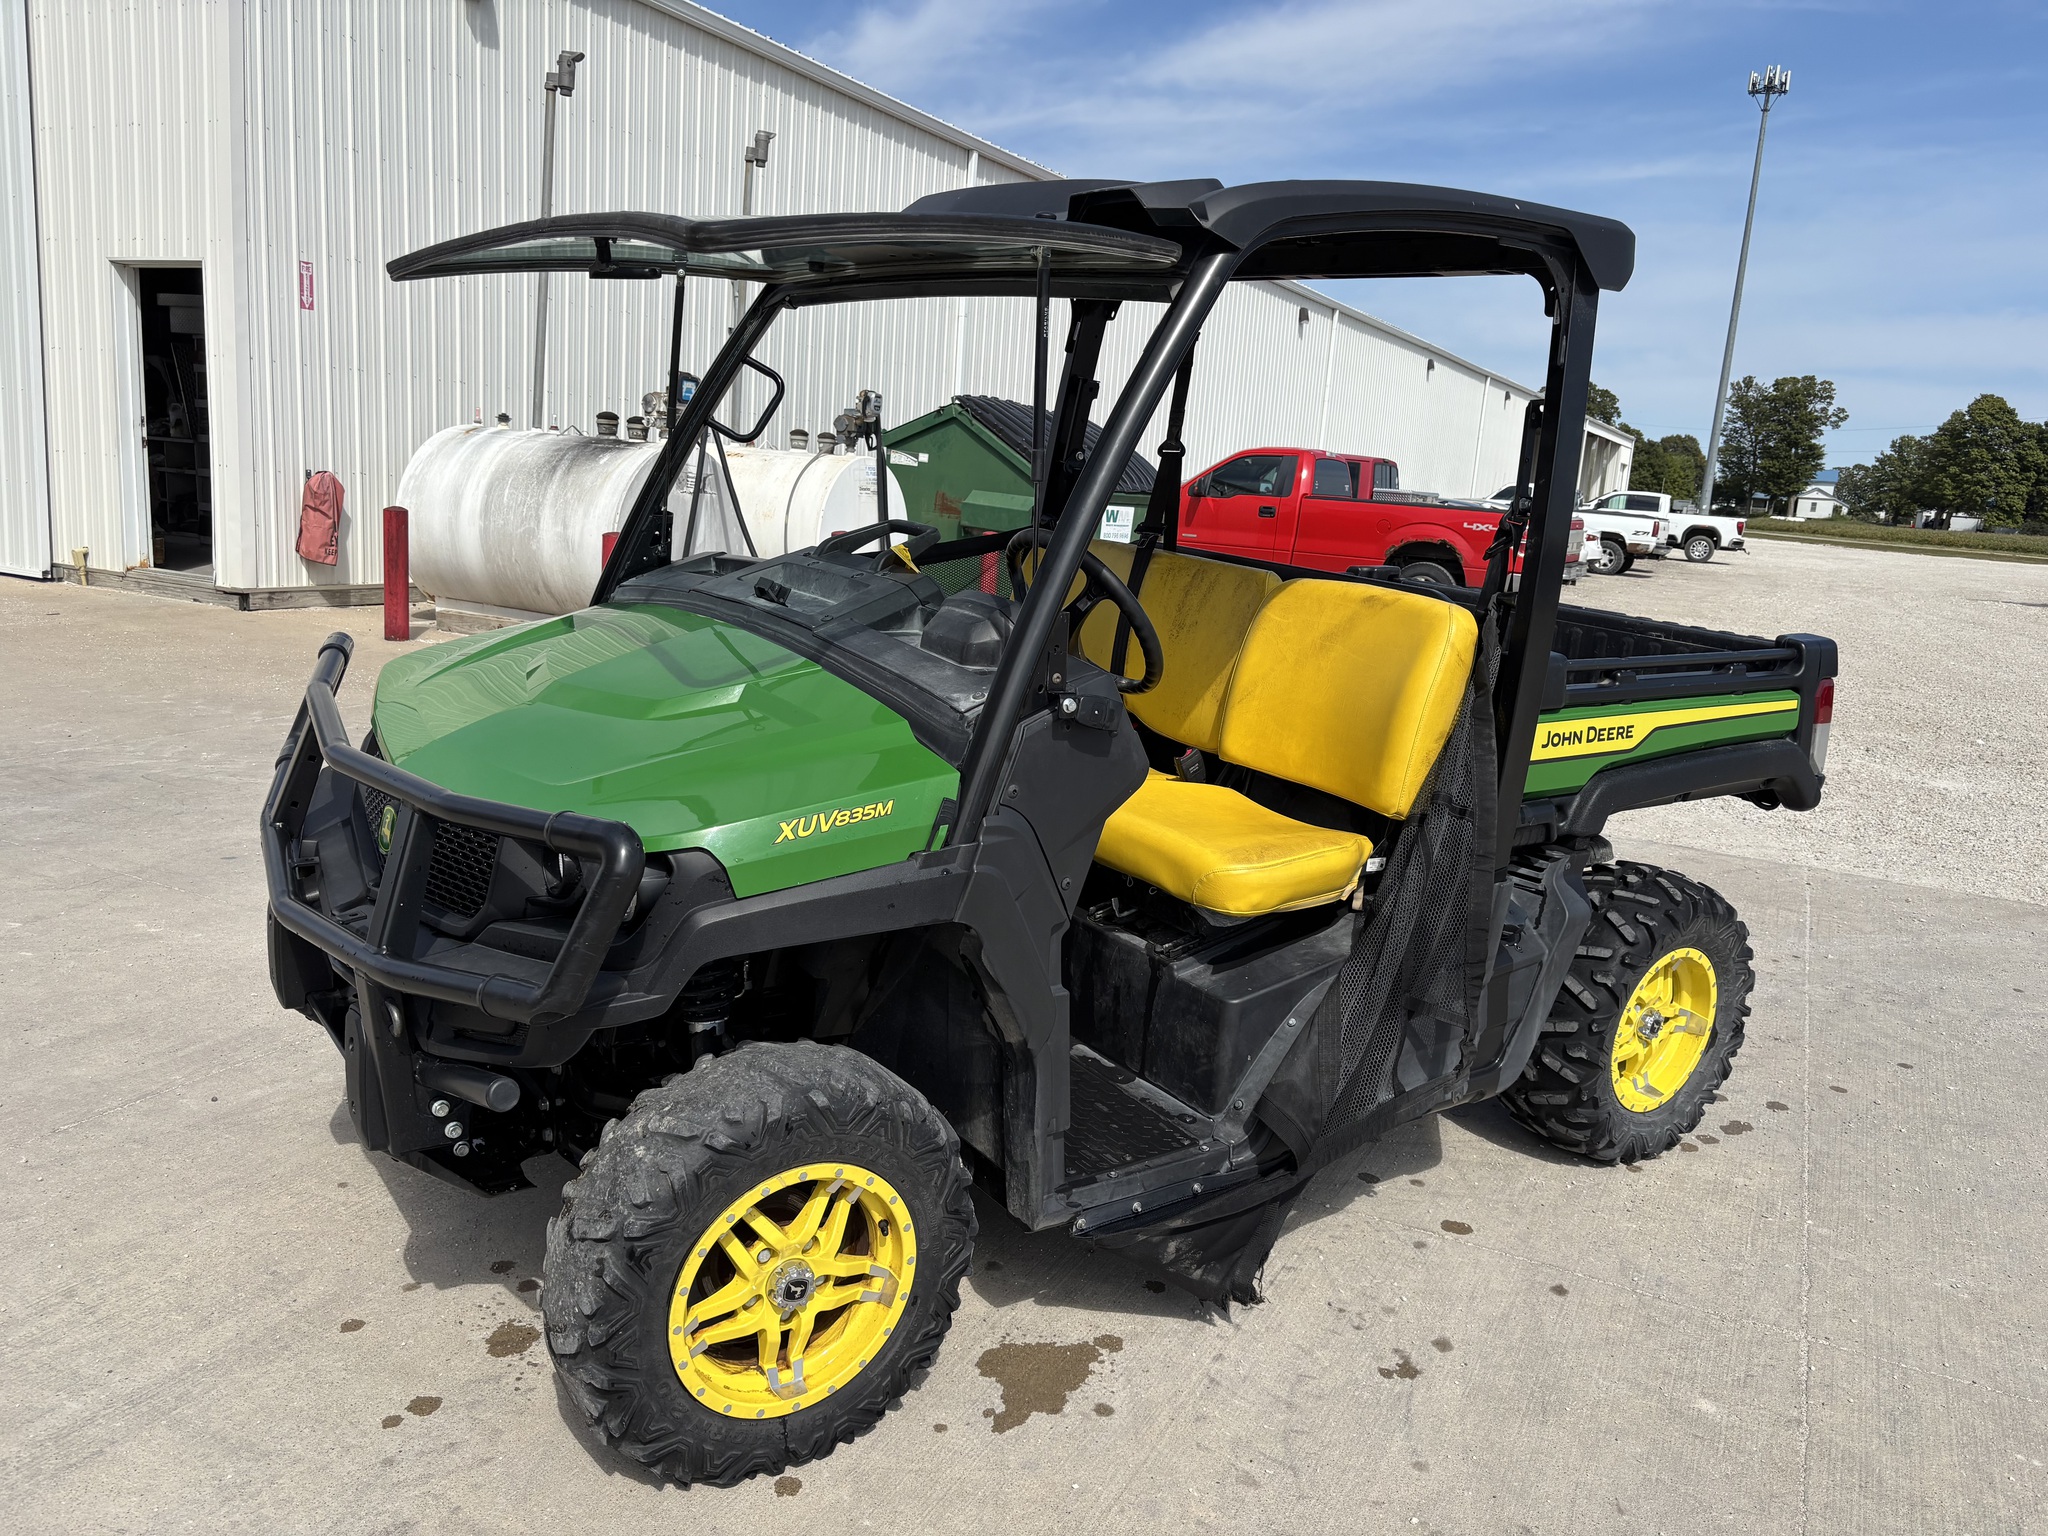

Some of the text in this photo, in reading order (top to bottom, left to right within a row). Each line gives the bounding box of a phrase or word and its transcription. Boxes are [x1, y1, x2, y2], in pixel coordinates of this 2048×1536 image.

[301, 265, 311, 273] FIRE
[1541, 724, 1635, 749] JOHN DEERE
[773, 799, 895, 845] XUV835M
